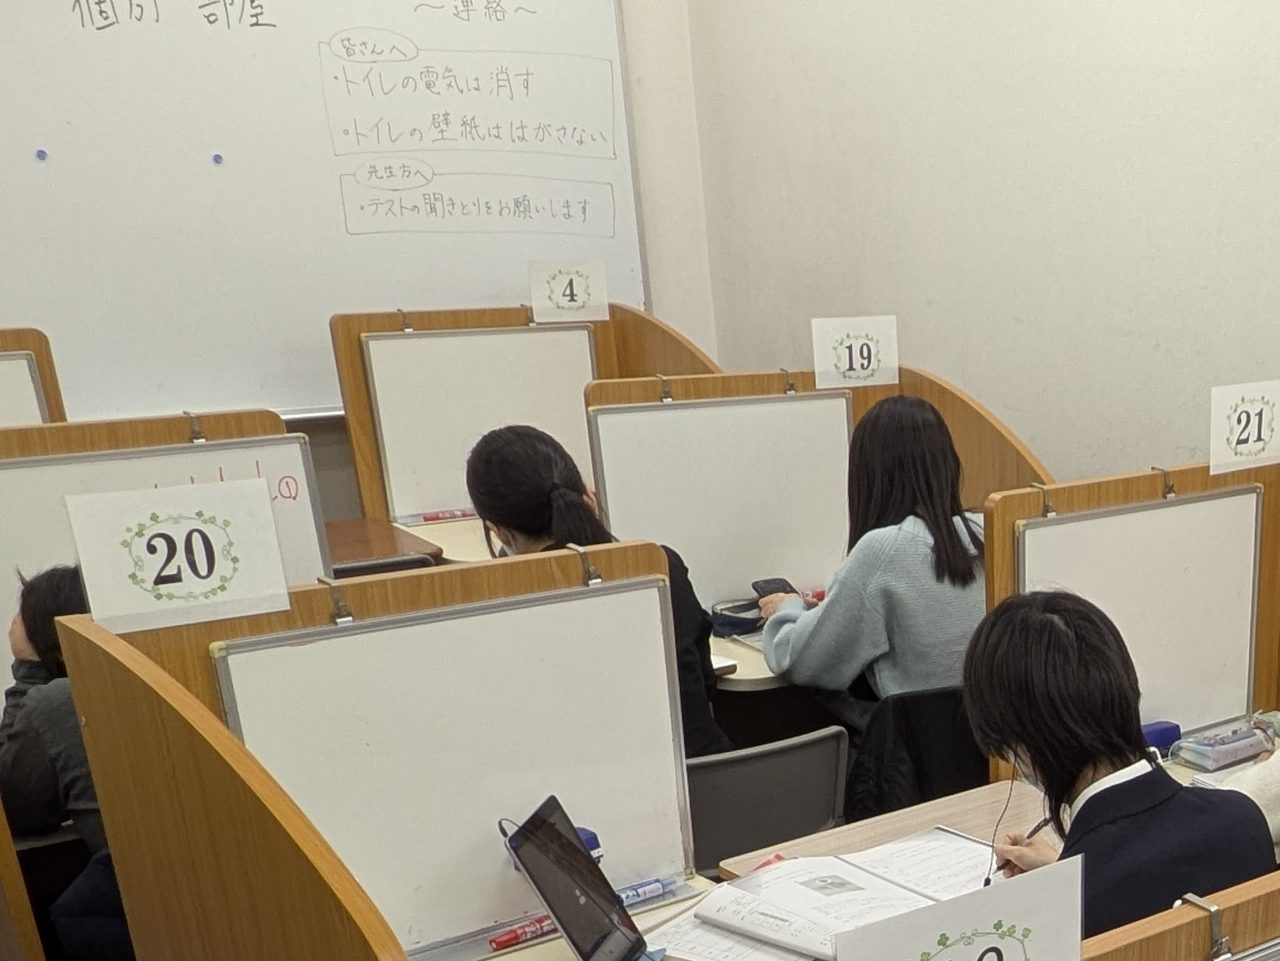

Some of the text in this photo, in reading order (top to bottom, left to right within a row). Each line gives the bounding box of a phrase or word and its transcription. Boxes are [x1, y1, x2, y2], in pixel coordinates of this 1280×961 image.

[340, 37, 408, 58] 皆さんへ
[367, 163, 429, 181] 先生方へ
[561, 278, 579, 303] 4
[845, 342, 872, 371] 19
[1235, 407, 1265, 446] 21
[146, 528, 216, 586] 20
